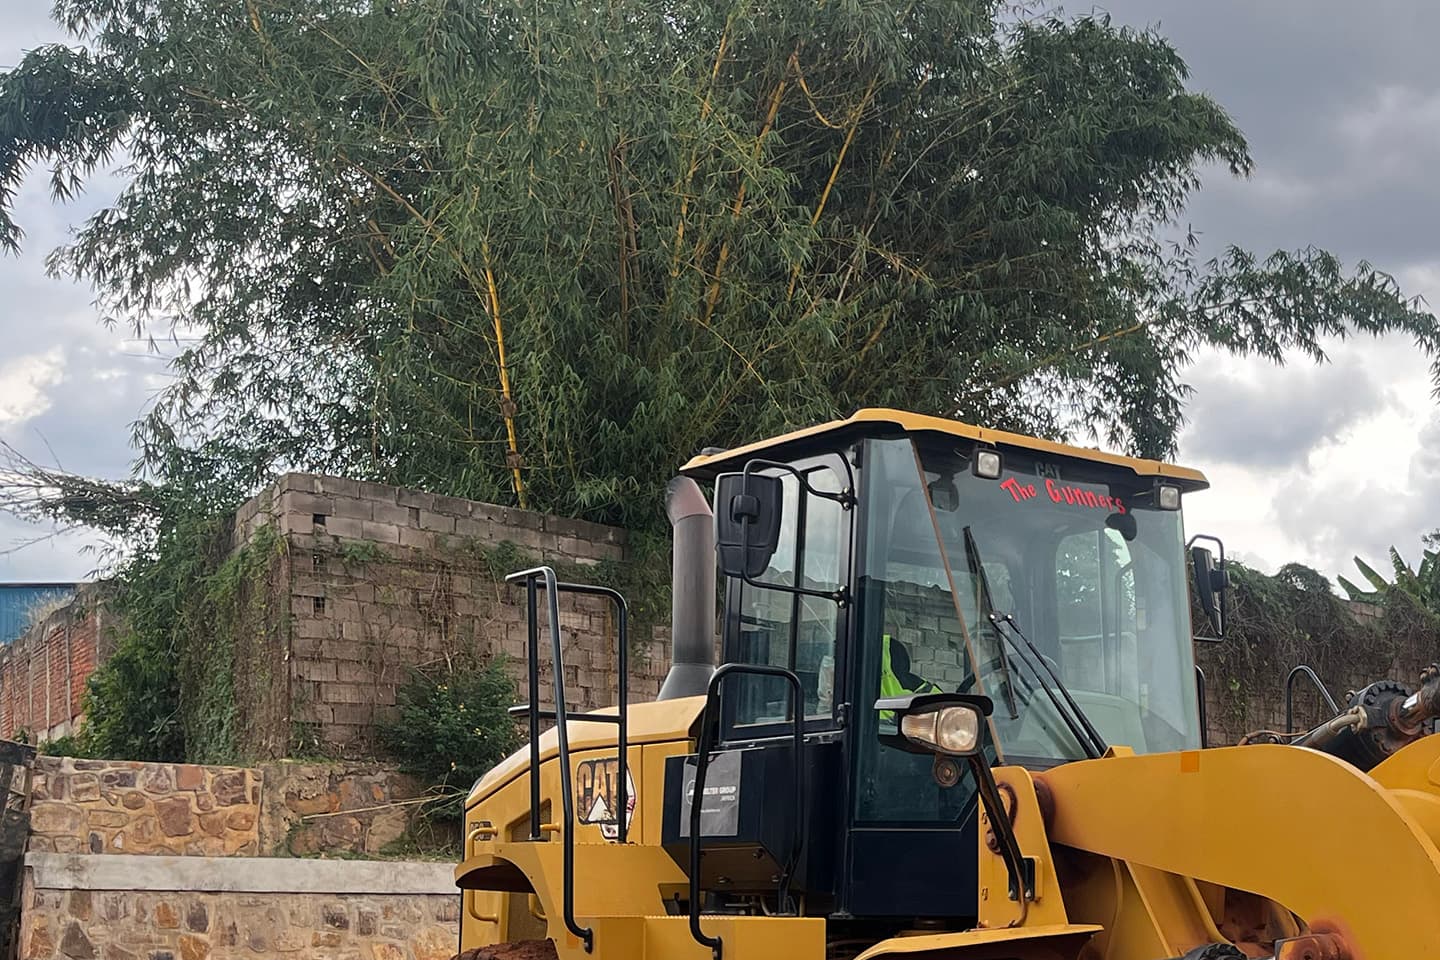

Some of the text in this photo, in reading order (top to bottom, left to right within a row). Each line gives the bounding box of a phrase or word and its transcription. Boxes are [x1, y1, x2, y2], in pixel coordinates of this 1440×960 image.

[1035, 462, 1061, 480] CAT
[1000, 476, 1126, 514] The Gunners
[577, 760, 620, 821] CAT
